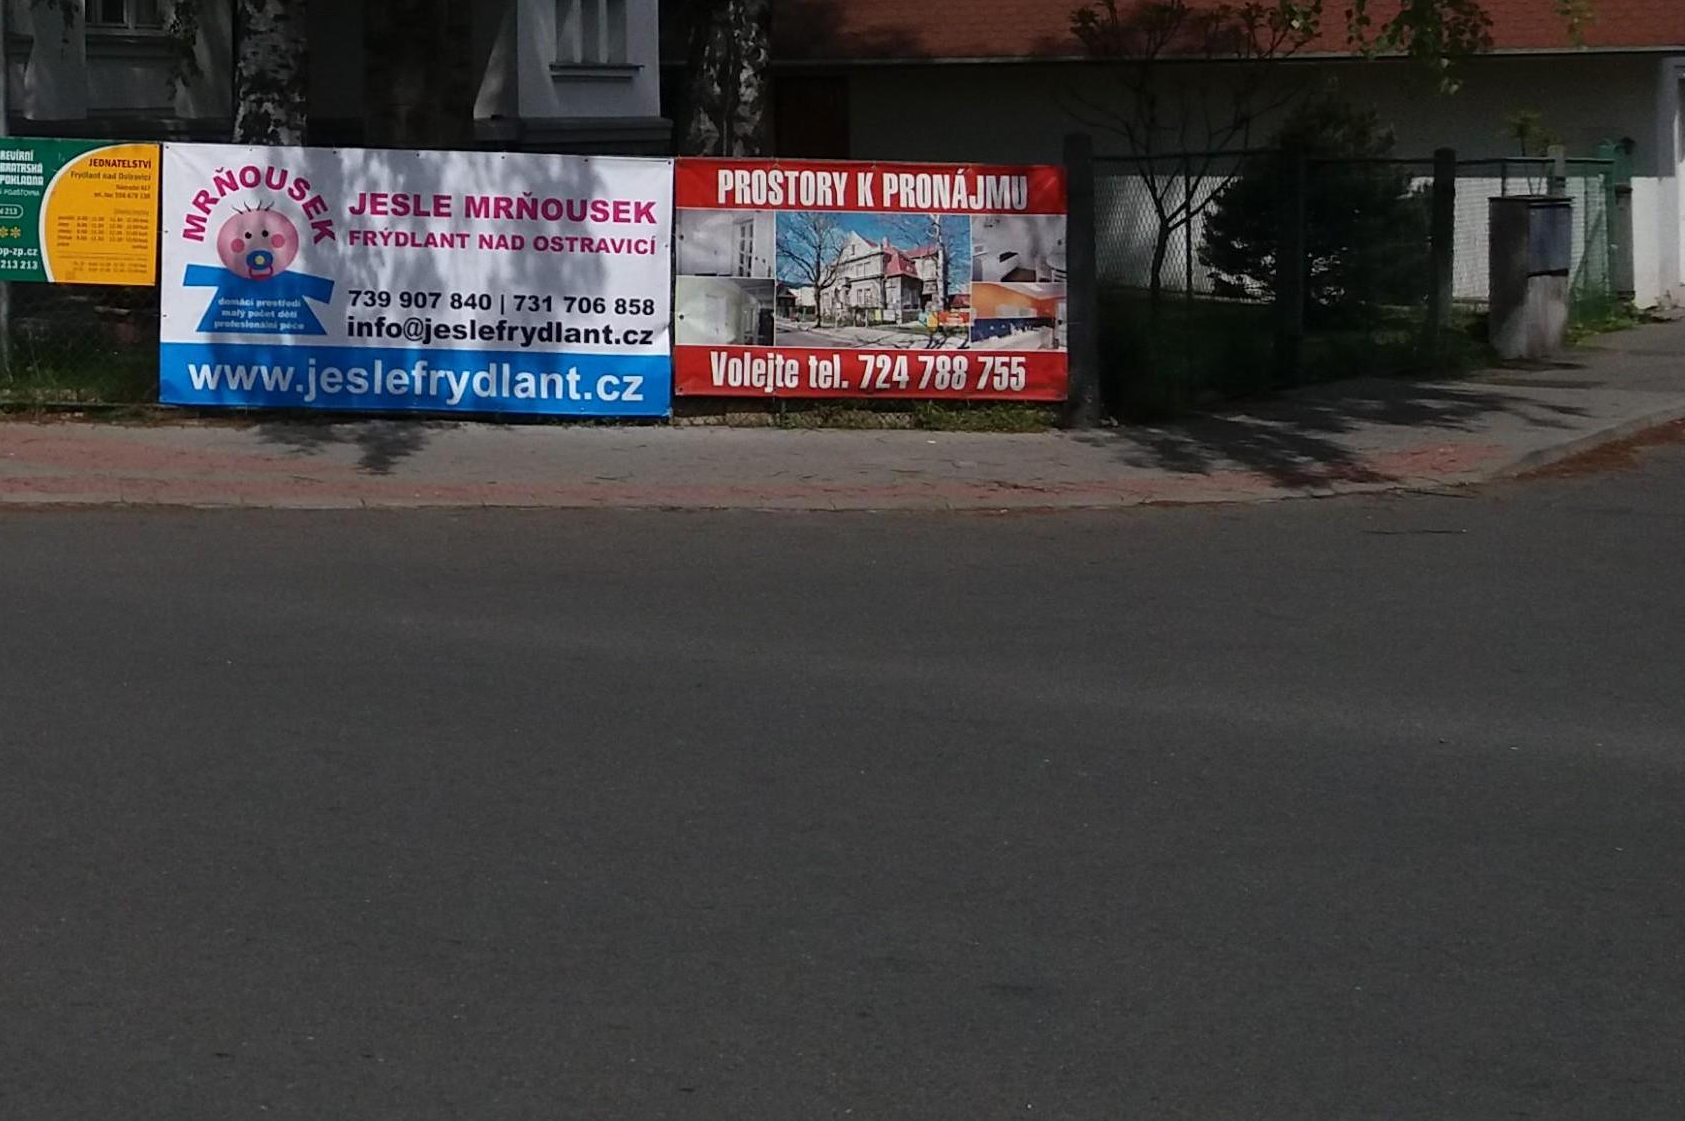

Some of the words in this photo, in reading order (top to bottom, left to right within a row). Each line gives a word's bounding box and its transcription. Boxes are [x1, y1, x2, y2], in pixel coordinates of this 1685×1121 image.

[88, 158, 151, 169] JEDNATELSTVÍ
[717, 169, 849, 207] PROSTORY
[858, 172, 875, 207] K
[882, 168, 1027, 209] PRONÁJMU
[5, 207, 18, 215] 213
[182, 165, 336, 245] MRŇOUSEK
[348, 192, 452, 218] JESLE
[465, 191, 658, 224] MRŇOUSEK
[348, 227, 470, 249] FRÝDLANT
[478, 234, 525, 251] NAD
[533, 235, 656, 255] OSTRAVICÍ
[0, 260, 18, 269] 213
[20, 260, 38, 270] 213
[221, 309, 246, 318] malý
[348, 290, 391, 308] 739
[399, 291, 442, 310] 907
[449, 293, 492, 311] 840
[513, 295, 553, 313] 731
[563, 297, 606, 315] 706
[614, 298, 655, 316] 858
[347, 315, 654, 347] info@jeslefrydlant.cz
[188, 358, 644, 406] www.jeslefrydlant.cz
[710, 351, 798, 393] Volejte
[808, 354, 849, 389] tel.
[858, 355, 909, 389] 724
[918, 355, 969, 390] 788
[976, 356, 1026, 391] 755
